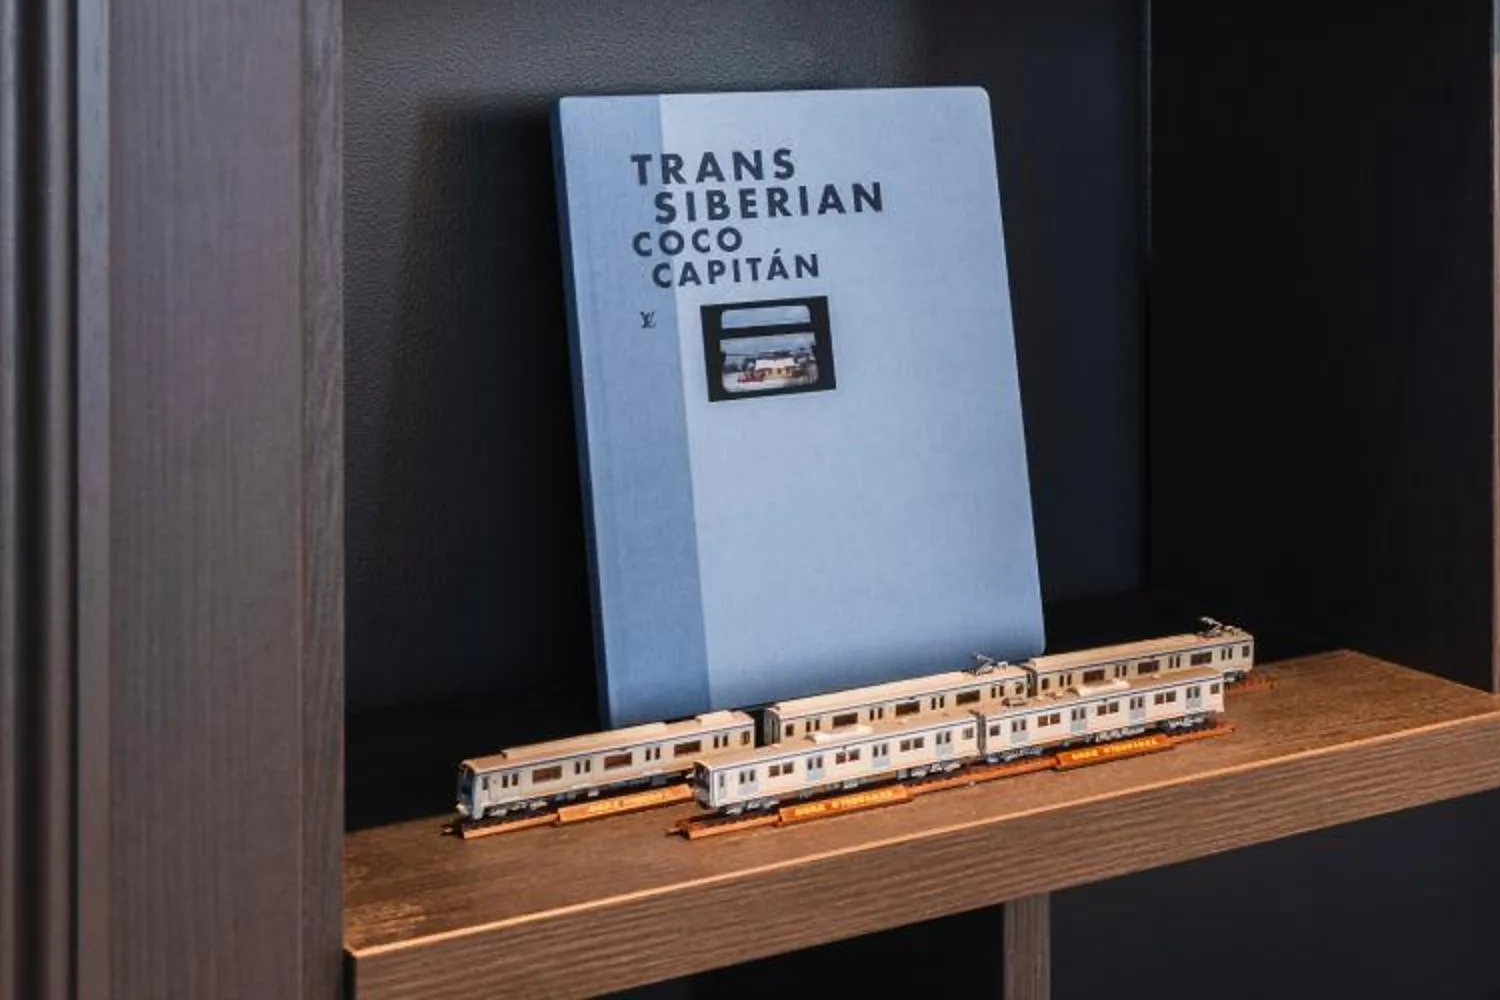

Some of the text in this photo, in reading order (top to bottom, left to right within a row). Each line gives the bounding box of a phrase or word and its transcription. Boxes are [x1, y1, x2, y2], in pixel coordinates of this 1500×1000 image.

[631, 147, 796, 186] TRANS
[654, 182, 884, 225] SIBERIAN
[632, 227, 743, 257] COCO
[652, 249, 820, 289] CAPITÁN
